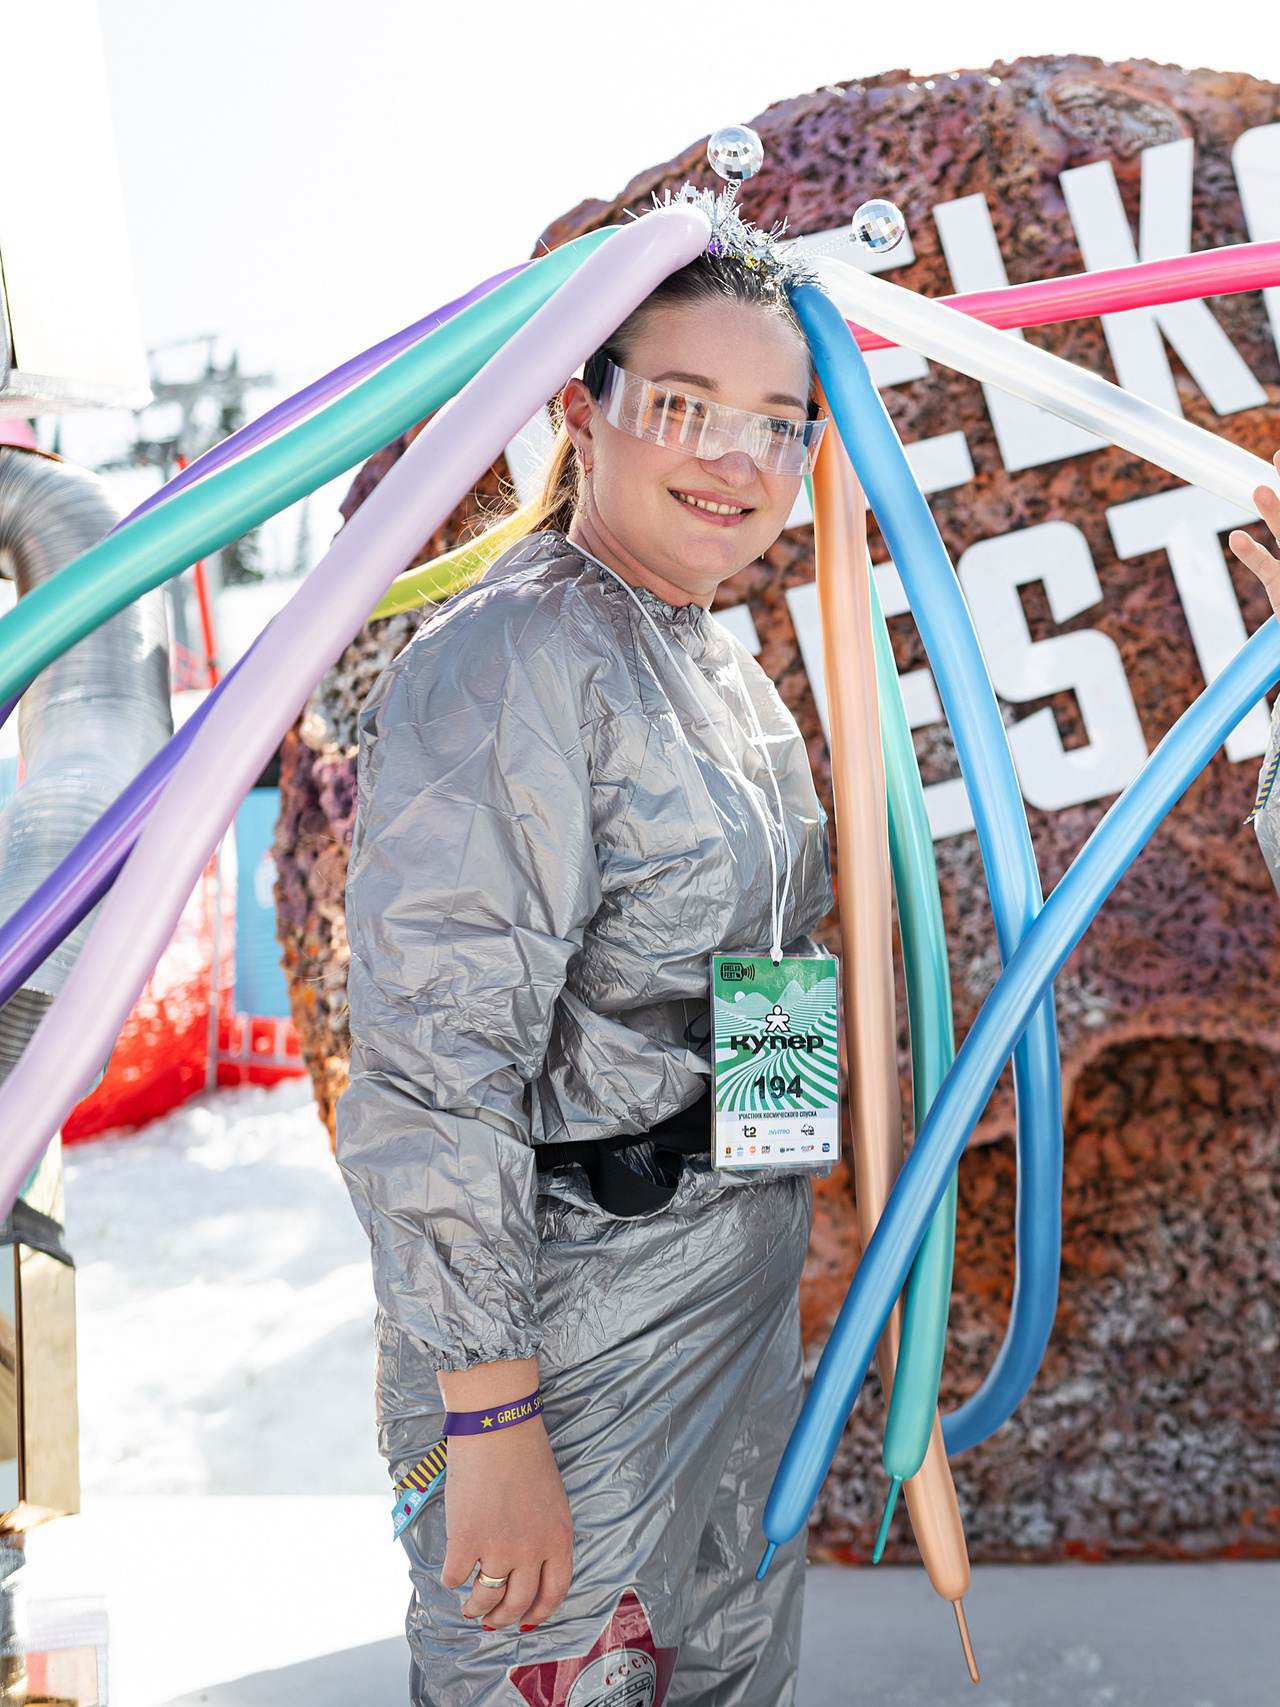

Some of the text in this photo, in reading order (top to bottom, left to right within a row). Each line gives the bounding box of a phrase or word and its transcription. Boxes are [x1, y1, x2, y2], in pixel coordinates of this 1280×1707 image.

[712, 485, 1272, 842] EST
[753, 1074, 804, 1099] 194
[738, 1110, 818, 1120] УЧАСТНИК КОСМИЧЕСКОГО СПУСКА
[742, 1124, 757, 1138] t2
[768, 1128, 791, 1136] INVITRO
[497, 1402, 533, 1424] GRELKA
